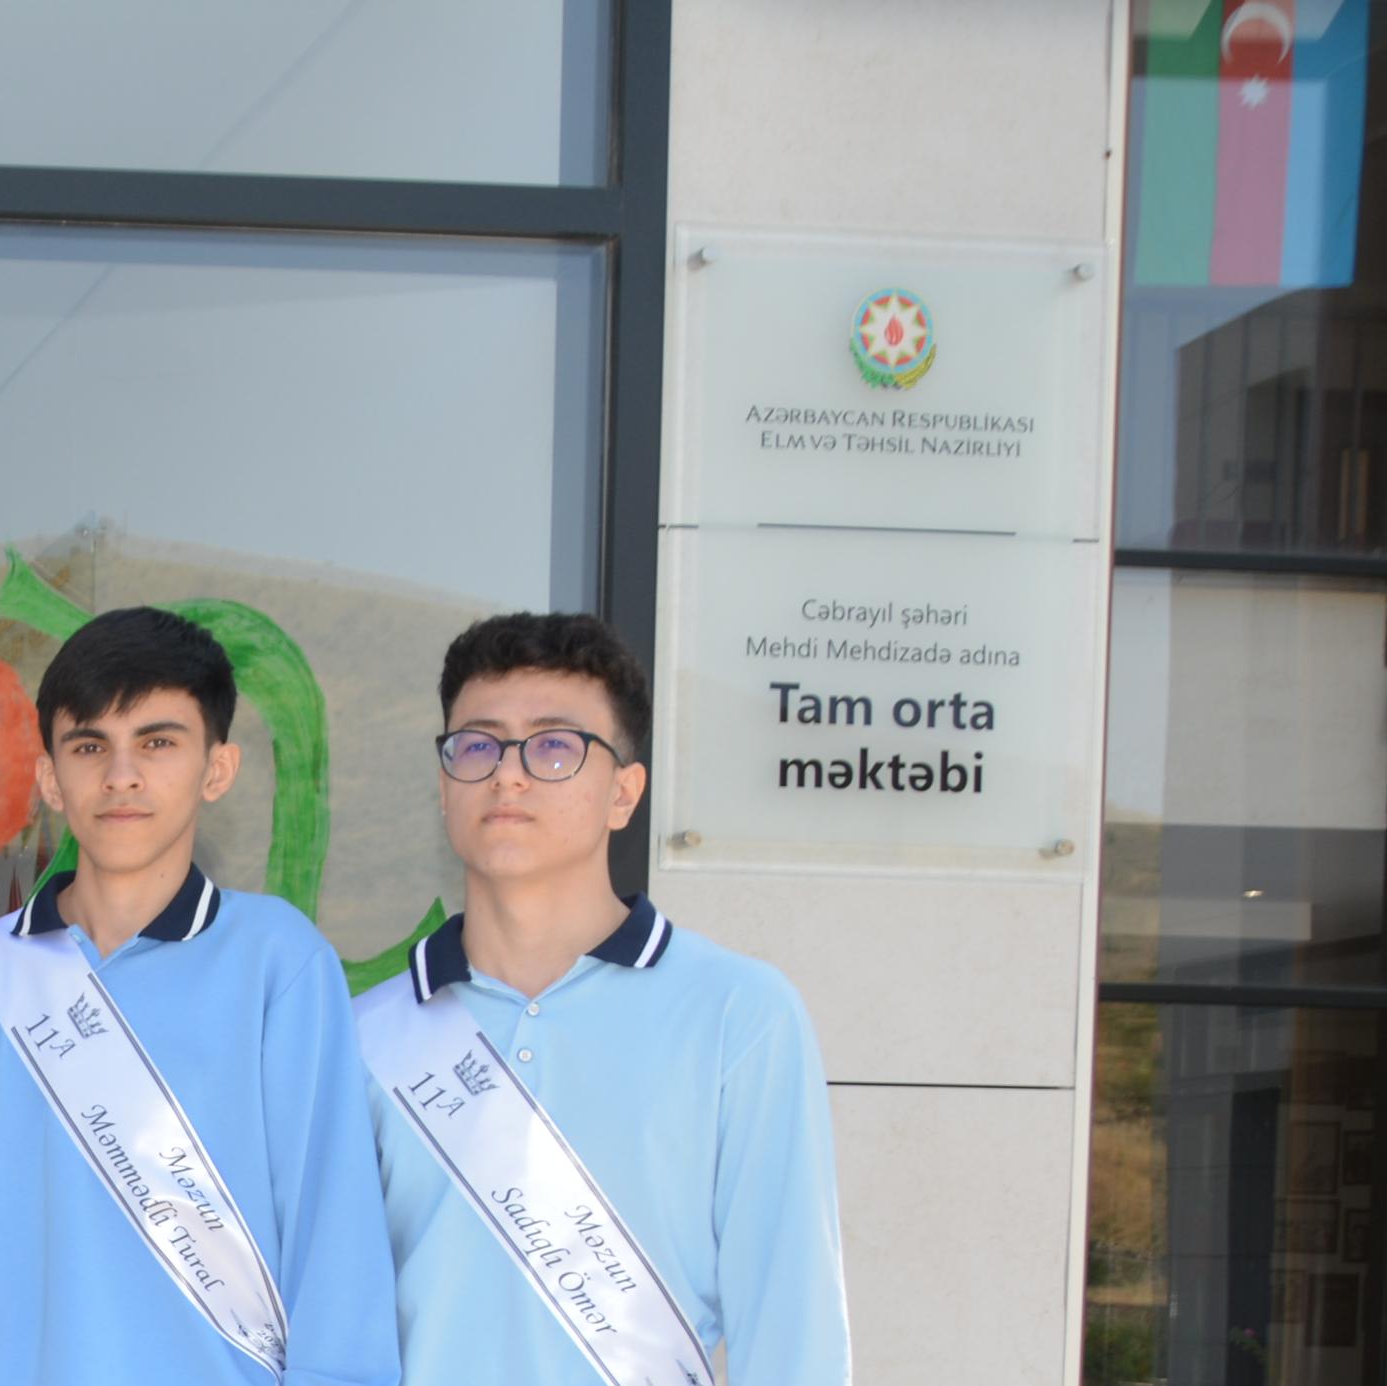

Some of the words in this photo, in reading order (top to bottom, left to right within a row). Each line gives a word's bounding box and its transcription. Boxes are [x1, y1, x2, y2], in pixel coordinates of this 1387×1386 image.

[745, 404, 885, 427] AZƏRBAYCAN
[760, 430, 806, 449] ELM
[811, 434, 836, 450] VƏ
[844, 433, 915, 454] TƏHSİL
[801, 599, 893, 628] Cəbrayıl
[900, 603, 968, 629] şəhəri
[746, 636, 818, 659] Mehdi
[826, 639, 952, 665] Mehdizadə
[959, 644, 1021, 667] adına
[770, 682, 873, 726] Tam
[892, 692, 995, 731] orta
[778, 747, 984, 793] məktəbi
[25, 1014, 77, 1059] 11A
[408, 1071, 466, 1118] 11A
[81, 1104, 179, 1229] Məmmədli
[169, 1226, 226, 1293] Tural
[159, 1147, 226, 1233] Məzun
[491, 1186, 571, 1268] Sadıqlı
[557, 1270, 619, 1335] Ömər
[564, 1204, 638, 1293] Məzun
